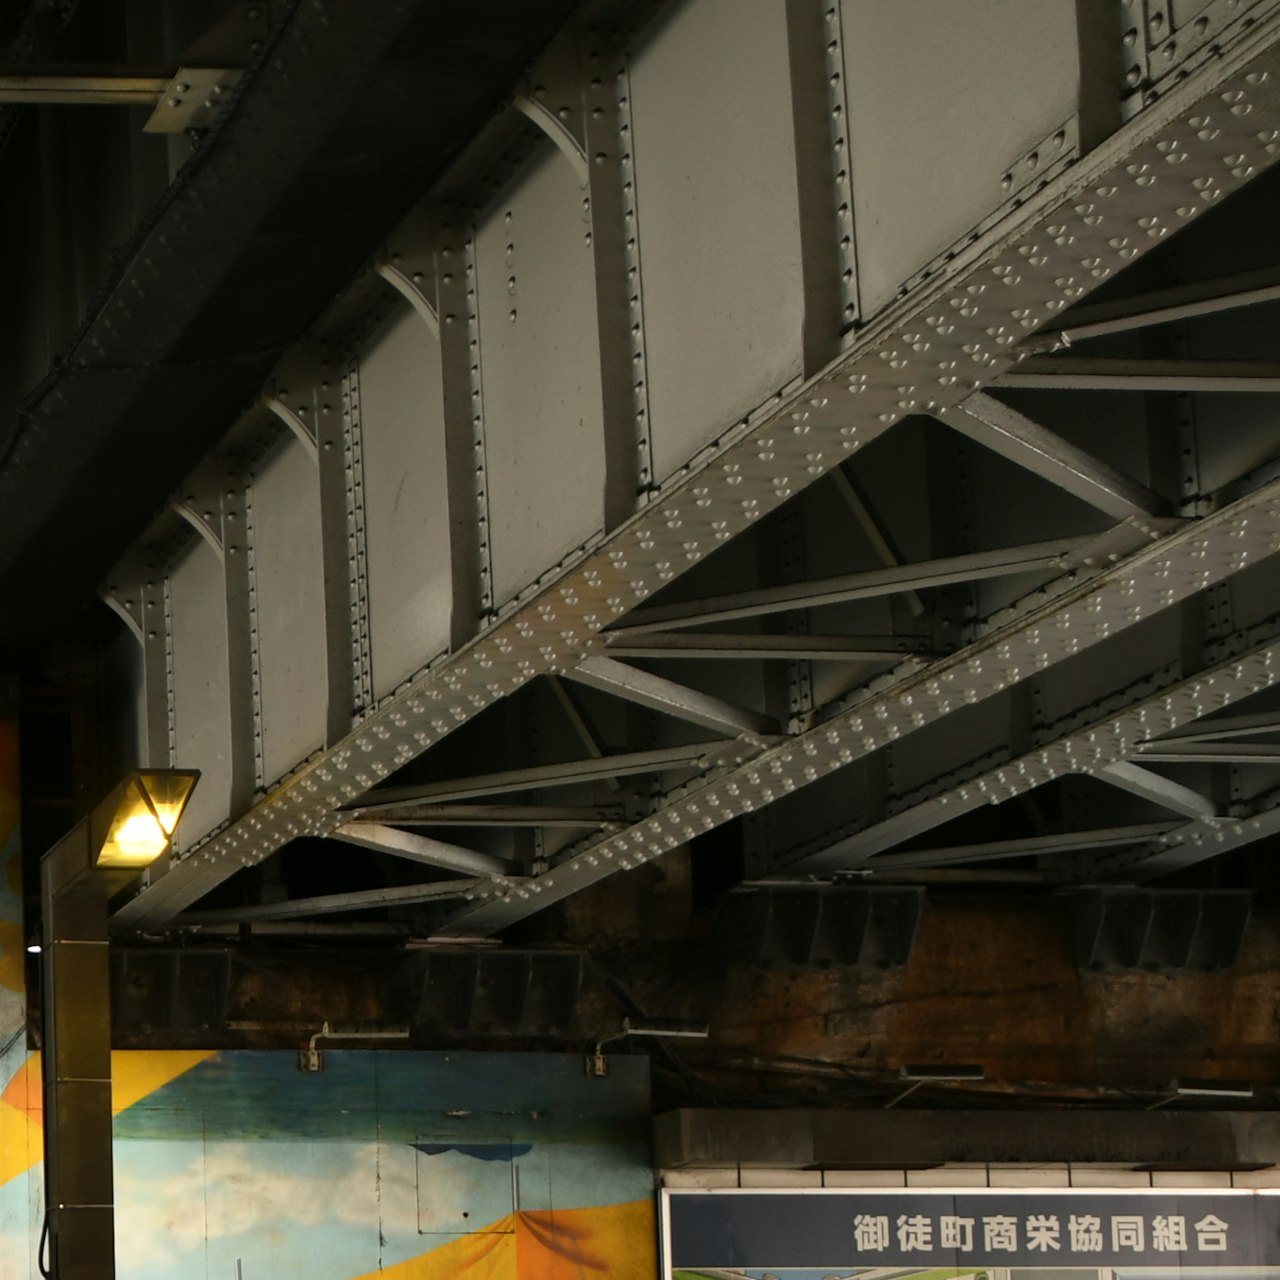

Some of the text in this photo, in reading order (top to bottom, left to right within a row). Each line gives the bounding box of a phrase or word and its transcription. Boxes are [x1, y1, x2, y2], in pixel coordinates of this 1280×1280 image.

[853, 1214, 1230, 1252] 御徒町商栄協同組合
